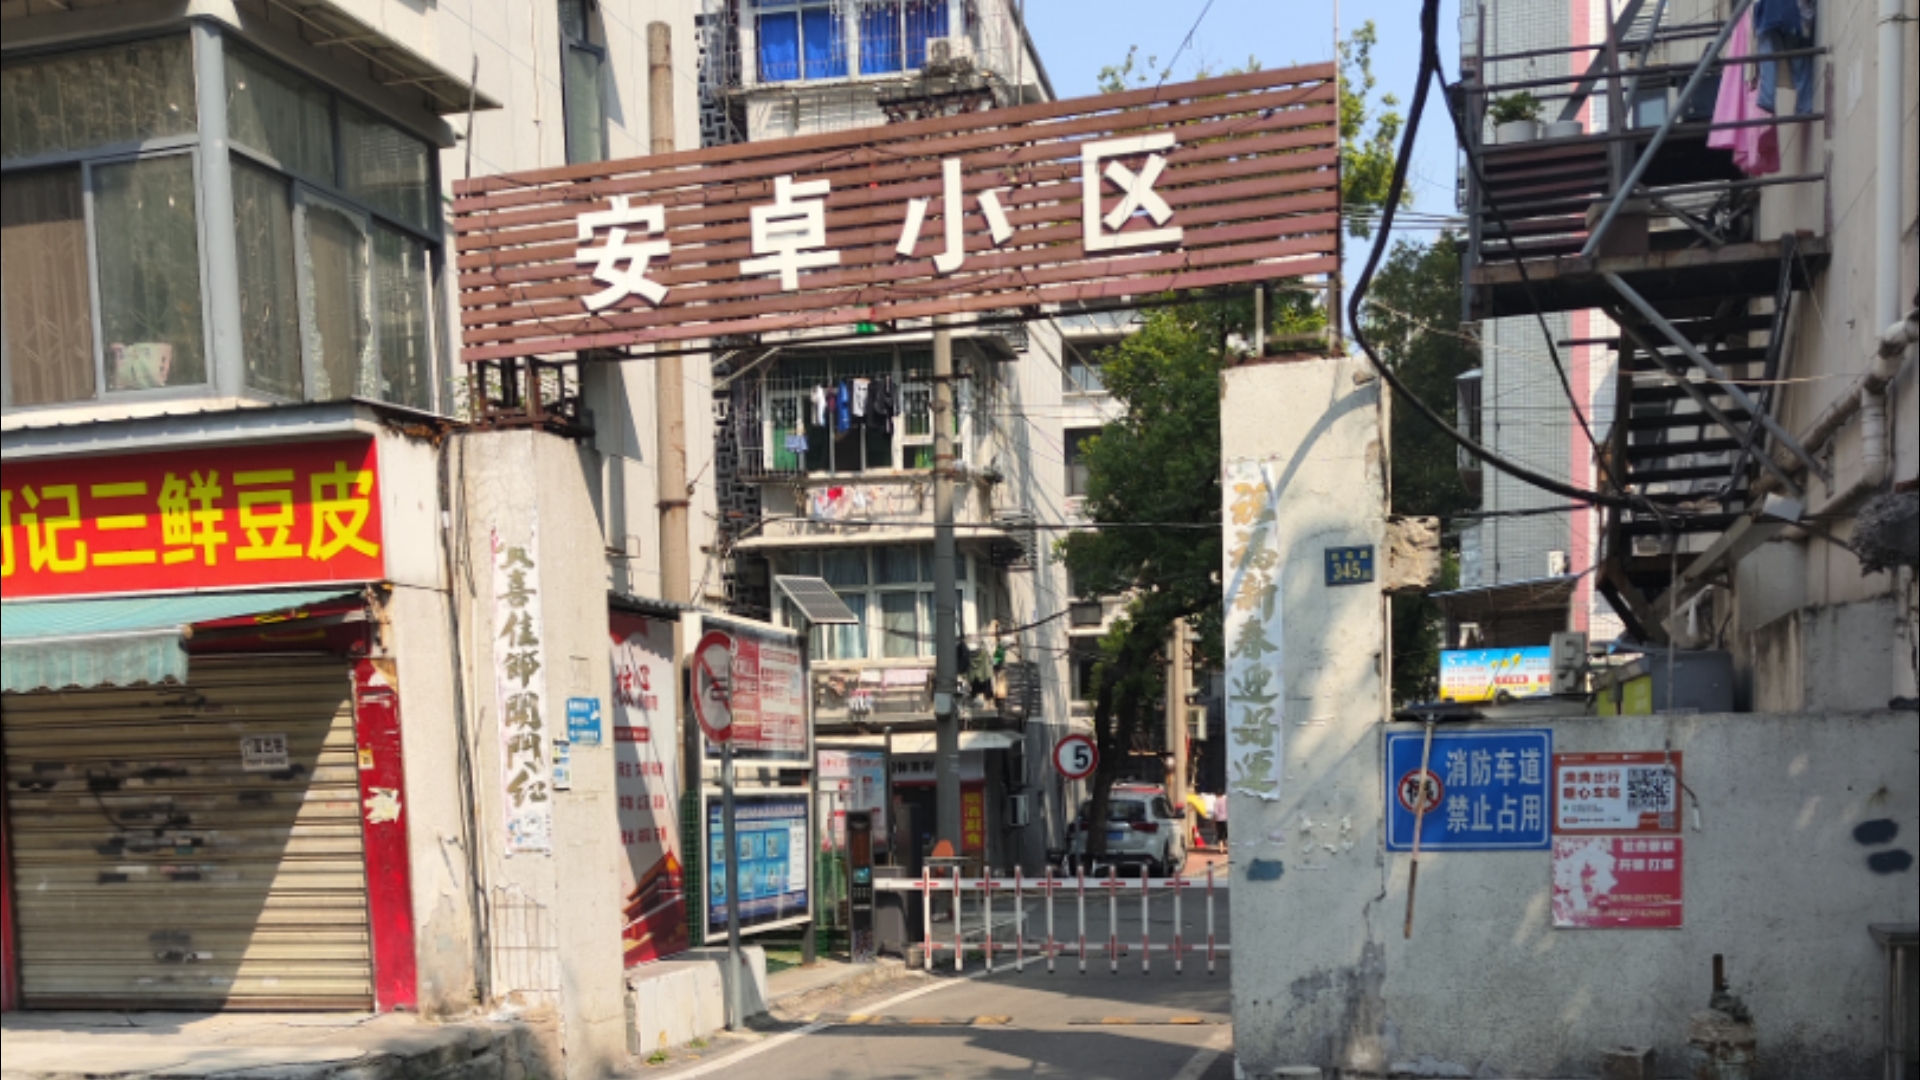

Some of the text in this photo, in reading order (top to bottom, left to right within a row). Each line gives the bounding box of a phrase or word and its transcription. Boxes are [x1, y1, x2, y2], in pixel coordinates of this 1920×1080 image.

[575, 132, 1184, 313] 安卓小区
[1074, 745, 1089, 769] 5
[1445, 747, 1542, 787] 消防车道
[1446, 794, 1541, 834] 禁止占用
